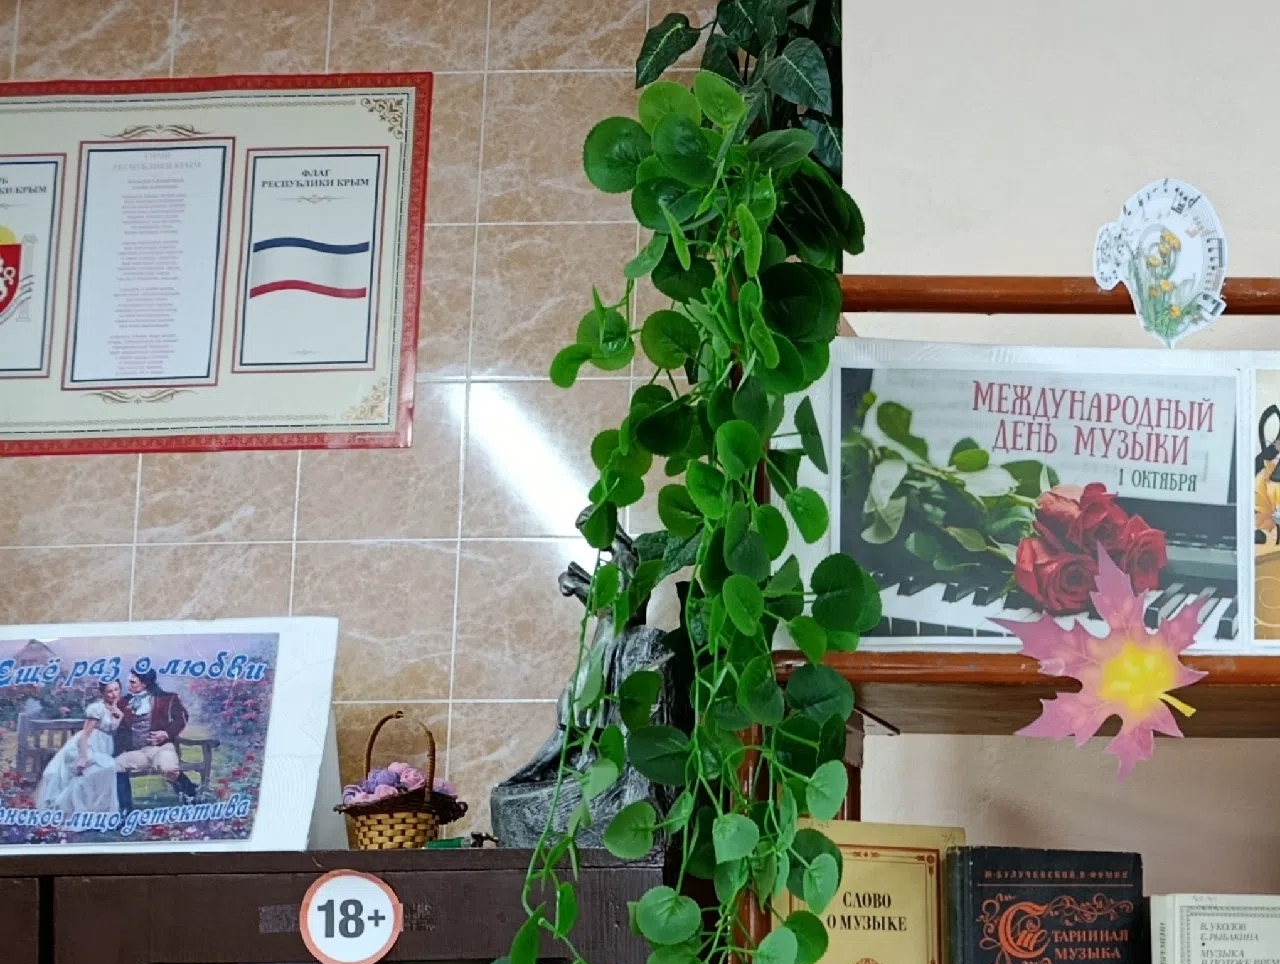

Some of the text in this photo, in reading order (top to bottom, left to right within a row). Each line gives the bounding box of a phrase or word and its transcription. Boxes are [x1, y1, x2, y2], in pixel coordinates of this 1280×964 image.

[261, 178, 369, 188] РЕСПУБЛИКИ КРЫМ
[301, 169, 331, 177] ФЛАГ
[972, 380, 1216, 433] МЕЖДУНАРОДНЫЙ
[992, 419, 1190, 466] ДЕНЬ МУЗЫКИ
[1118, 468, 1197, 492] 1 ОКТЯБРЯ
[64, 656, 121, 687] раз
[134, 656, 151, 678] о
[158, 651, 267, 682] любви
[67, 793, 250, 836] лицо детектива
[842, 890, 892, 909] СЛОВО
[317, 899, 386, 938] 18+
[827, 915, 907, 932] О МУЗЫКЕ
[1053, 947, 1121, 960] МУЗЫКА
[1201, 949, 1245, 958] МУЗЫКА
